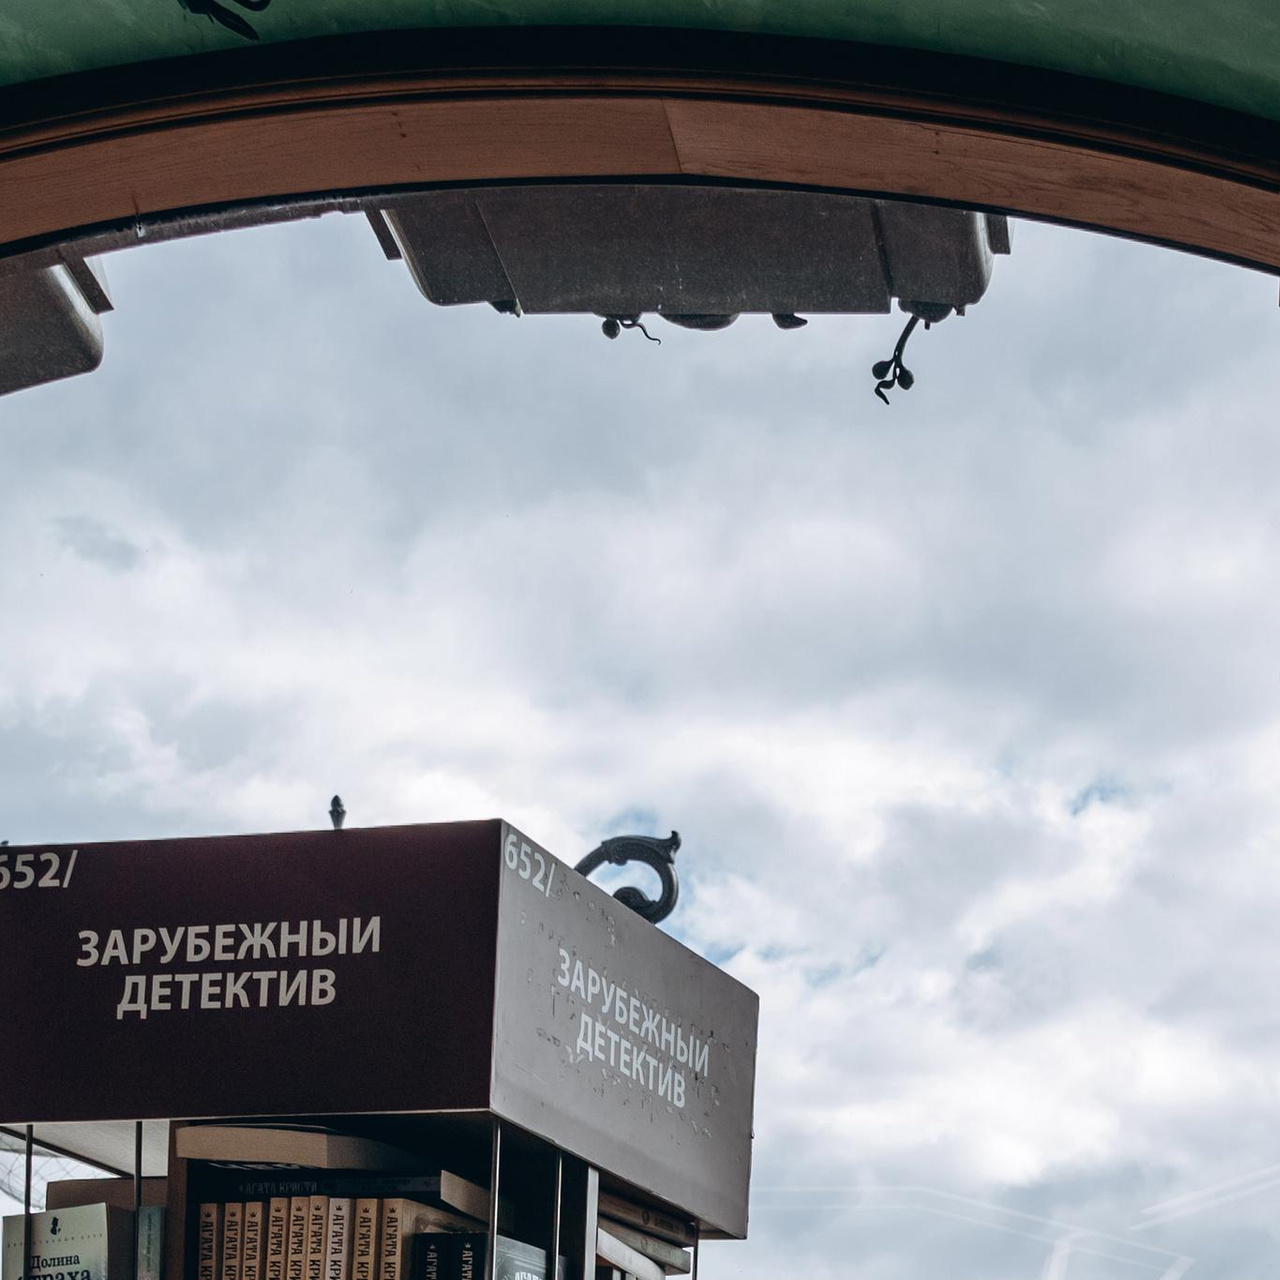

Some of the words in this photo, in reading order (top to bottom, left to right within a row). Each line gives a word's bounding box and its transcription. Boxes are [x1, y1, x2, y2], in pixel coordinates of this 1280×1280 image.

[504, 833, 556, 897] 652/
[116, 968, 337, 1020] ДЕТЕКТИВ
[576, 1012, 686, 1108] ДЕТЕКТИВ
[271, 1215, 283, 1256] АГАТА
[290, 1215, 304, 1256] АГАТА
[310, 1214, 323, 1256] АГАТА
[331, 1214, 344, 1255] АГАТА
[358, 1216, 371, 1257] АГАТА
[385, 1216, 398, 1257] АГАТА
[30, 1254, 80, 1272] Долина
